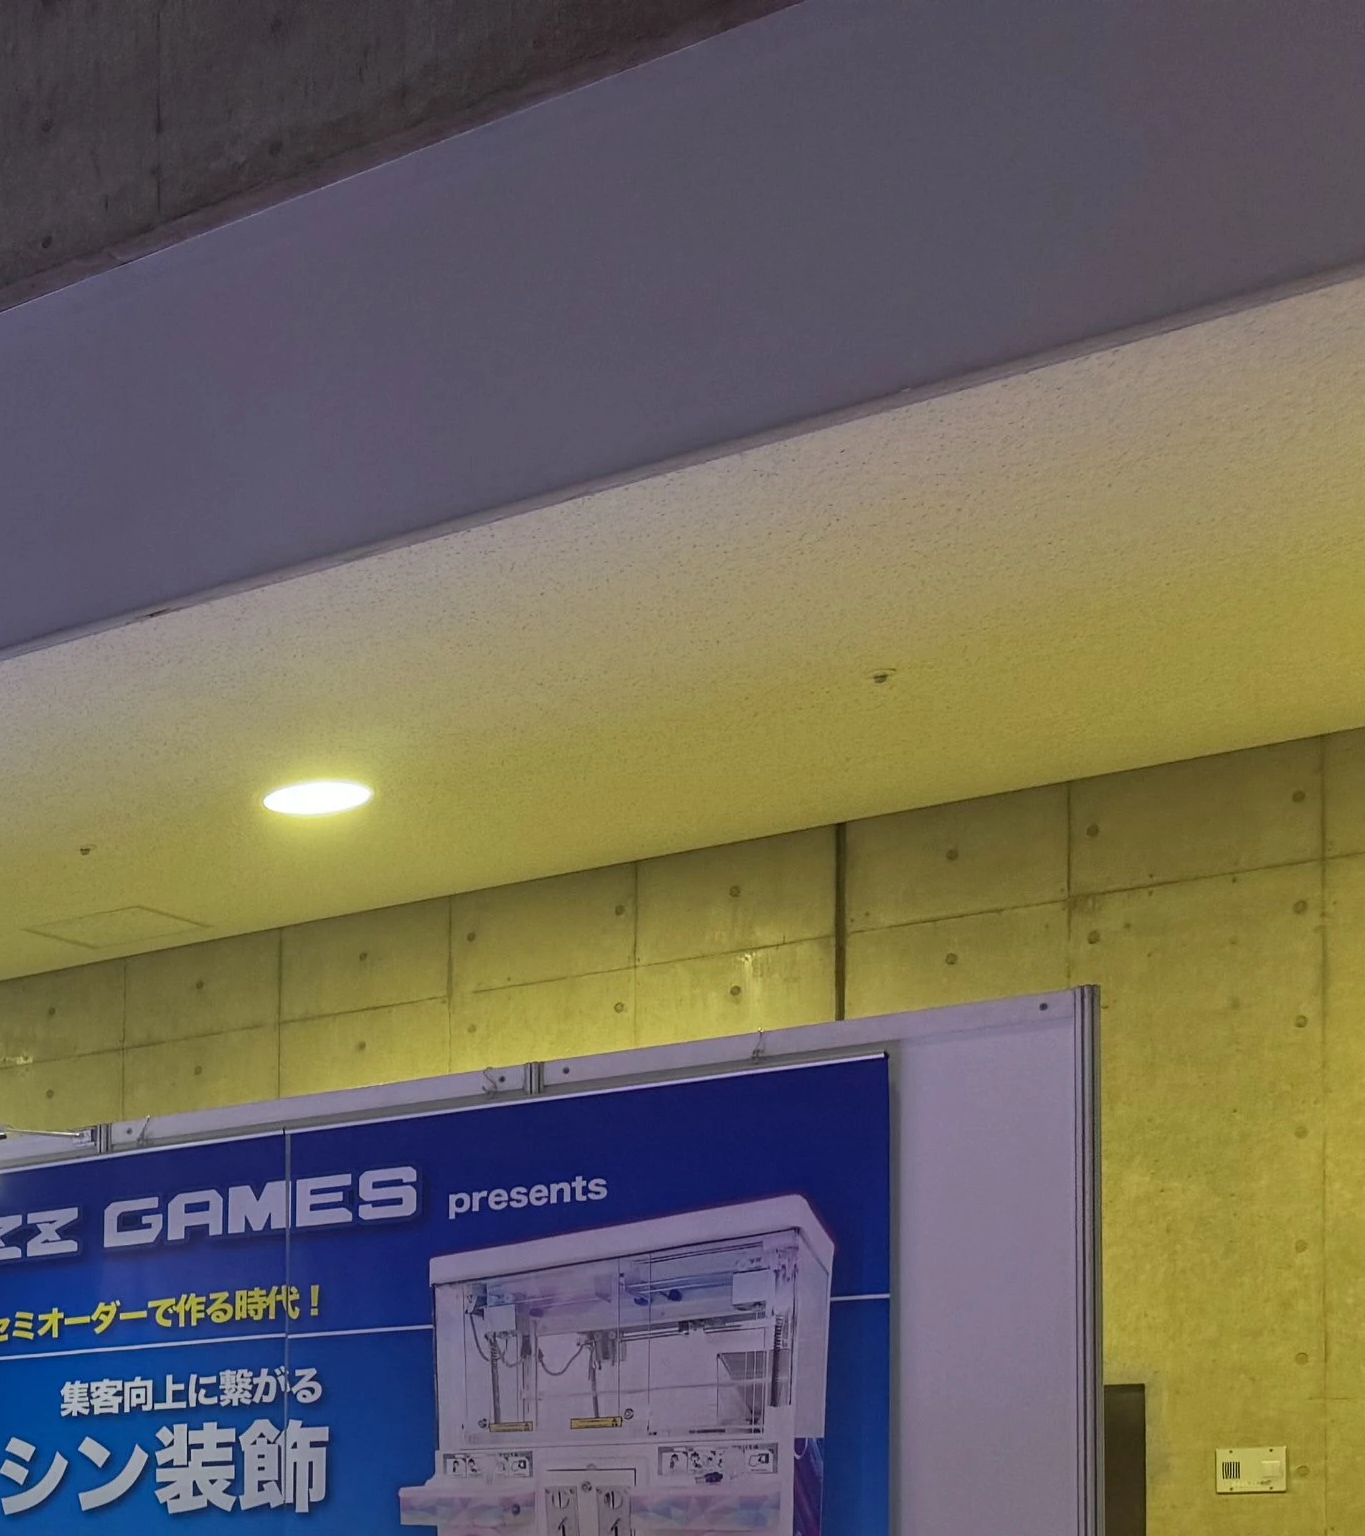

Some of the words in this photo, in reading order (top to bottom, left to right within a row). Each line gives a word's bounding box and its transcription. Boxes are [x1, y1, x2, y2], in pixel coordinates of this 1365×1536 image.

[103, 1165, 419, 1249] GAMES
[447, 1173, 609, 1220] presents
[59, 1368, 323, 1418] 集客向上に繋がる
